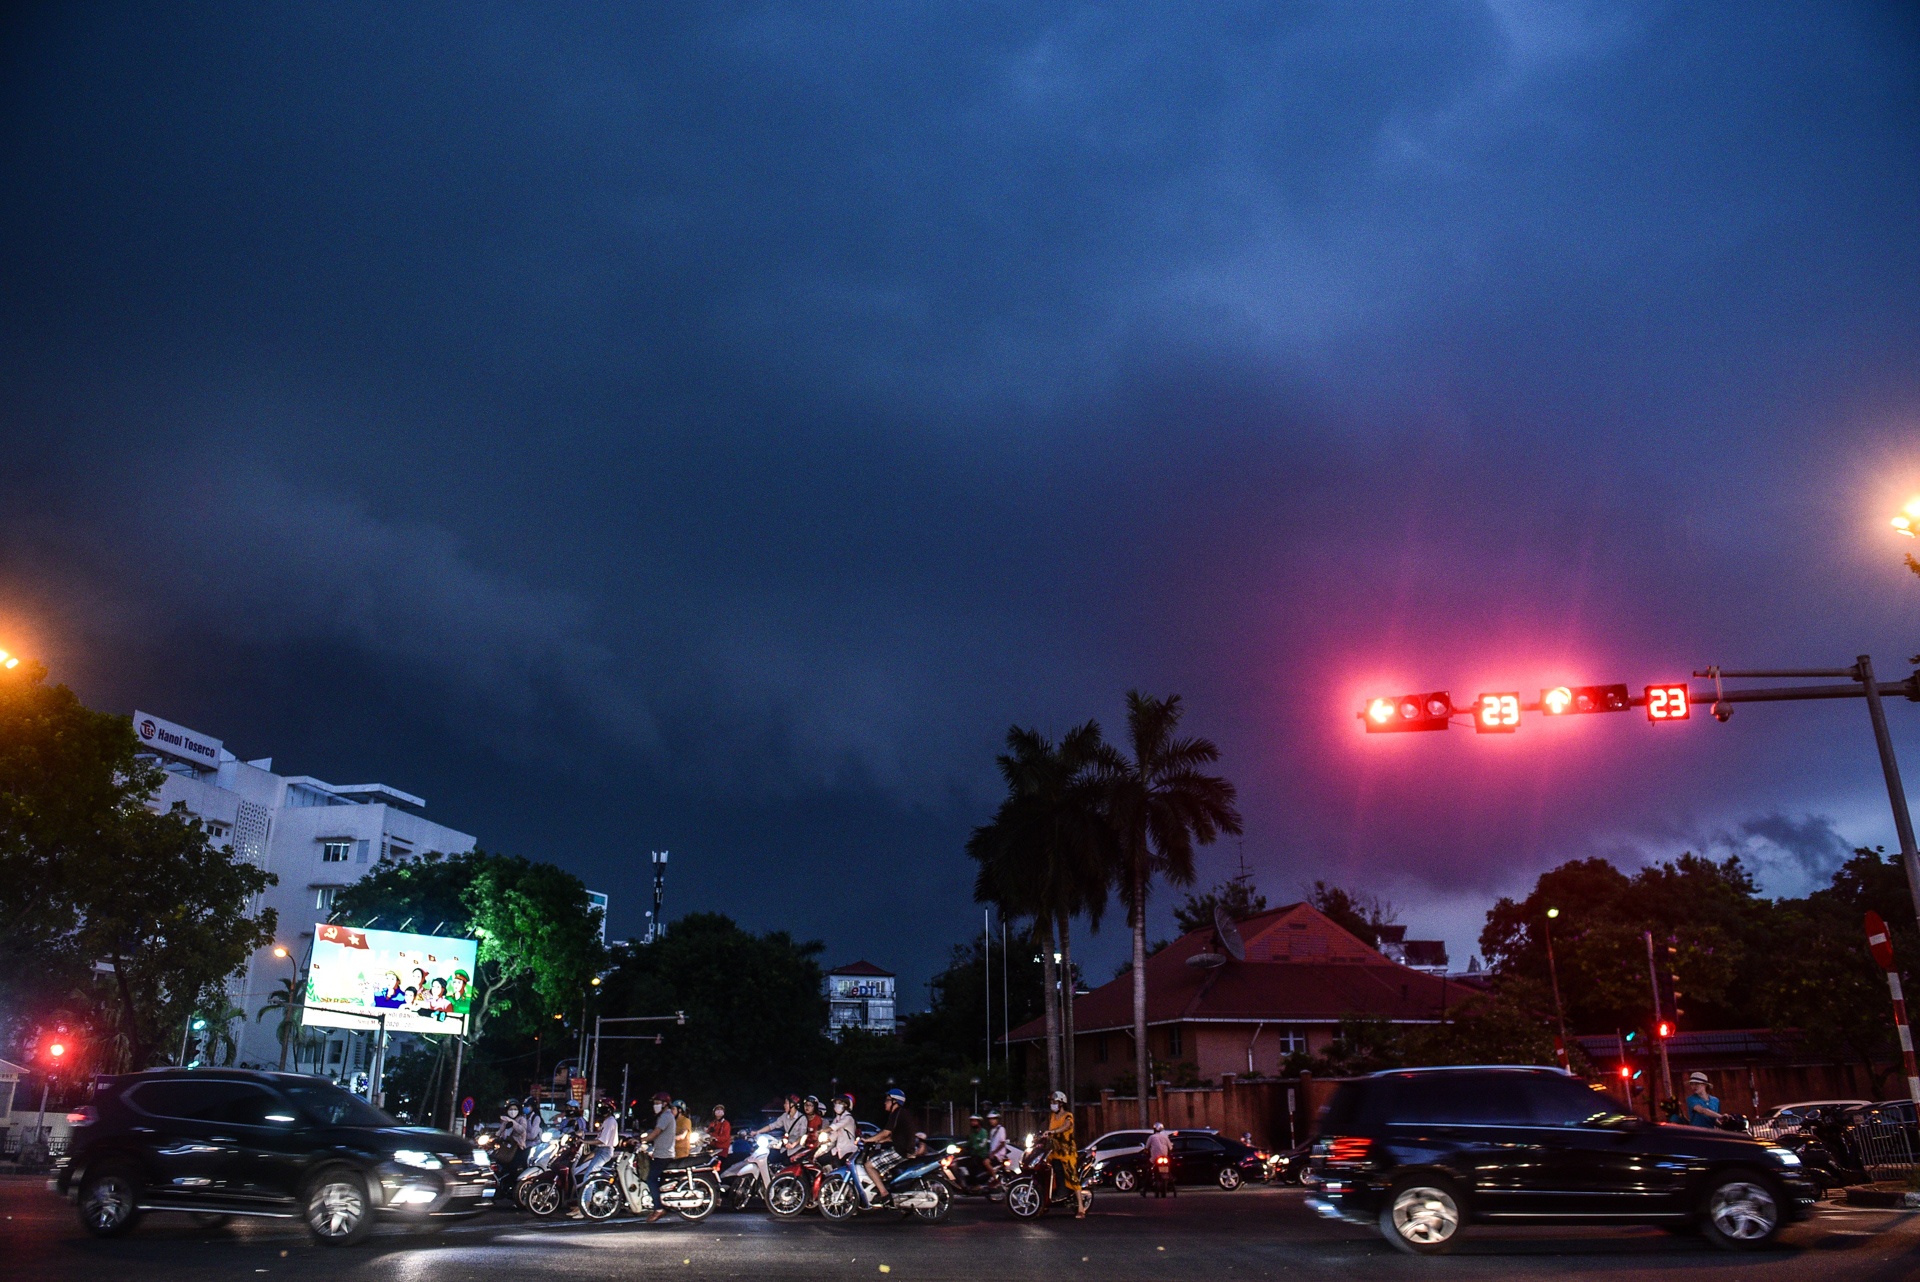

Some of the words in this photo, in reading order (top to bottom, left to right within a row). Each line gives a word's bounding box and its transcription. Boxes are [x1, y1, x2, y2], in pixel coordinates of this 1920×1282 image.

[1482, 695, 1519, 726] 23
[1649, 687, 1688, 719] 23
[158, 728, 183, 747] Hanoi
[184, 737, 215, 758] Toserco
